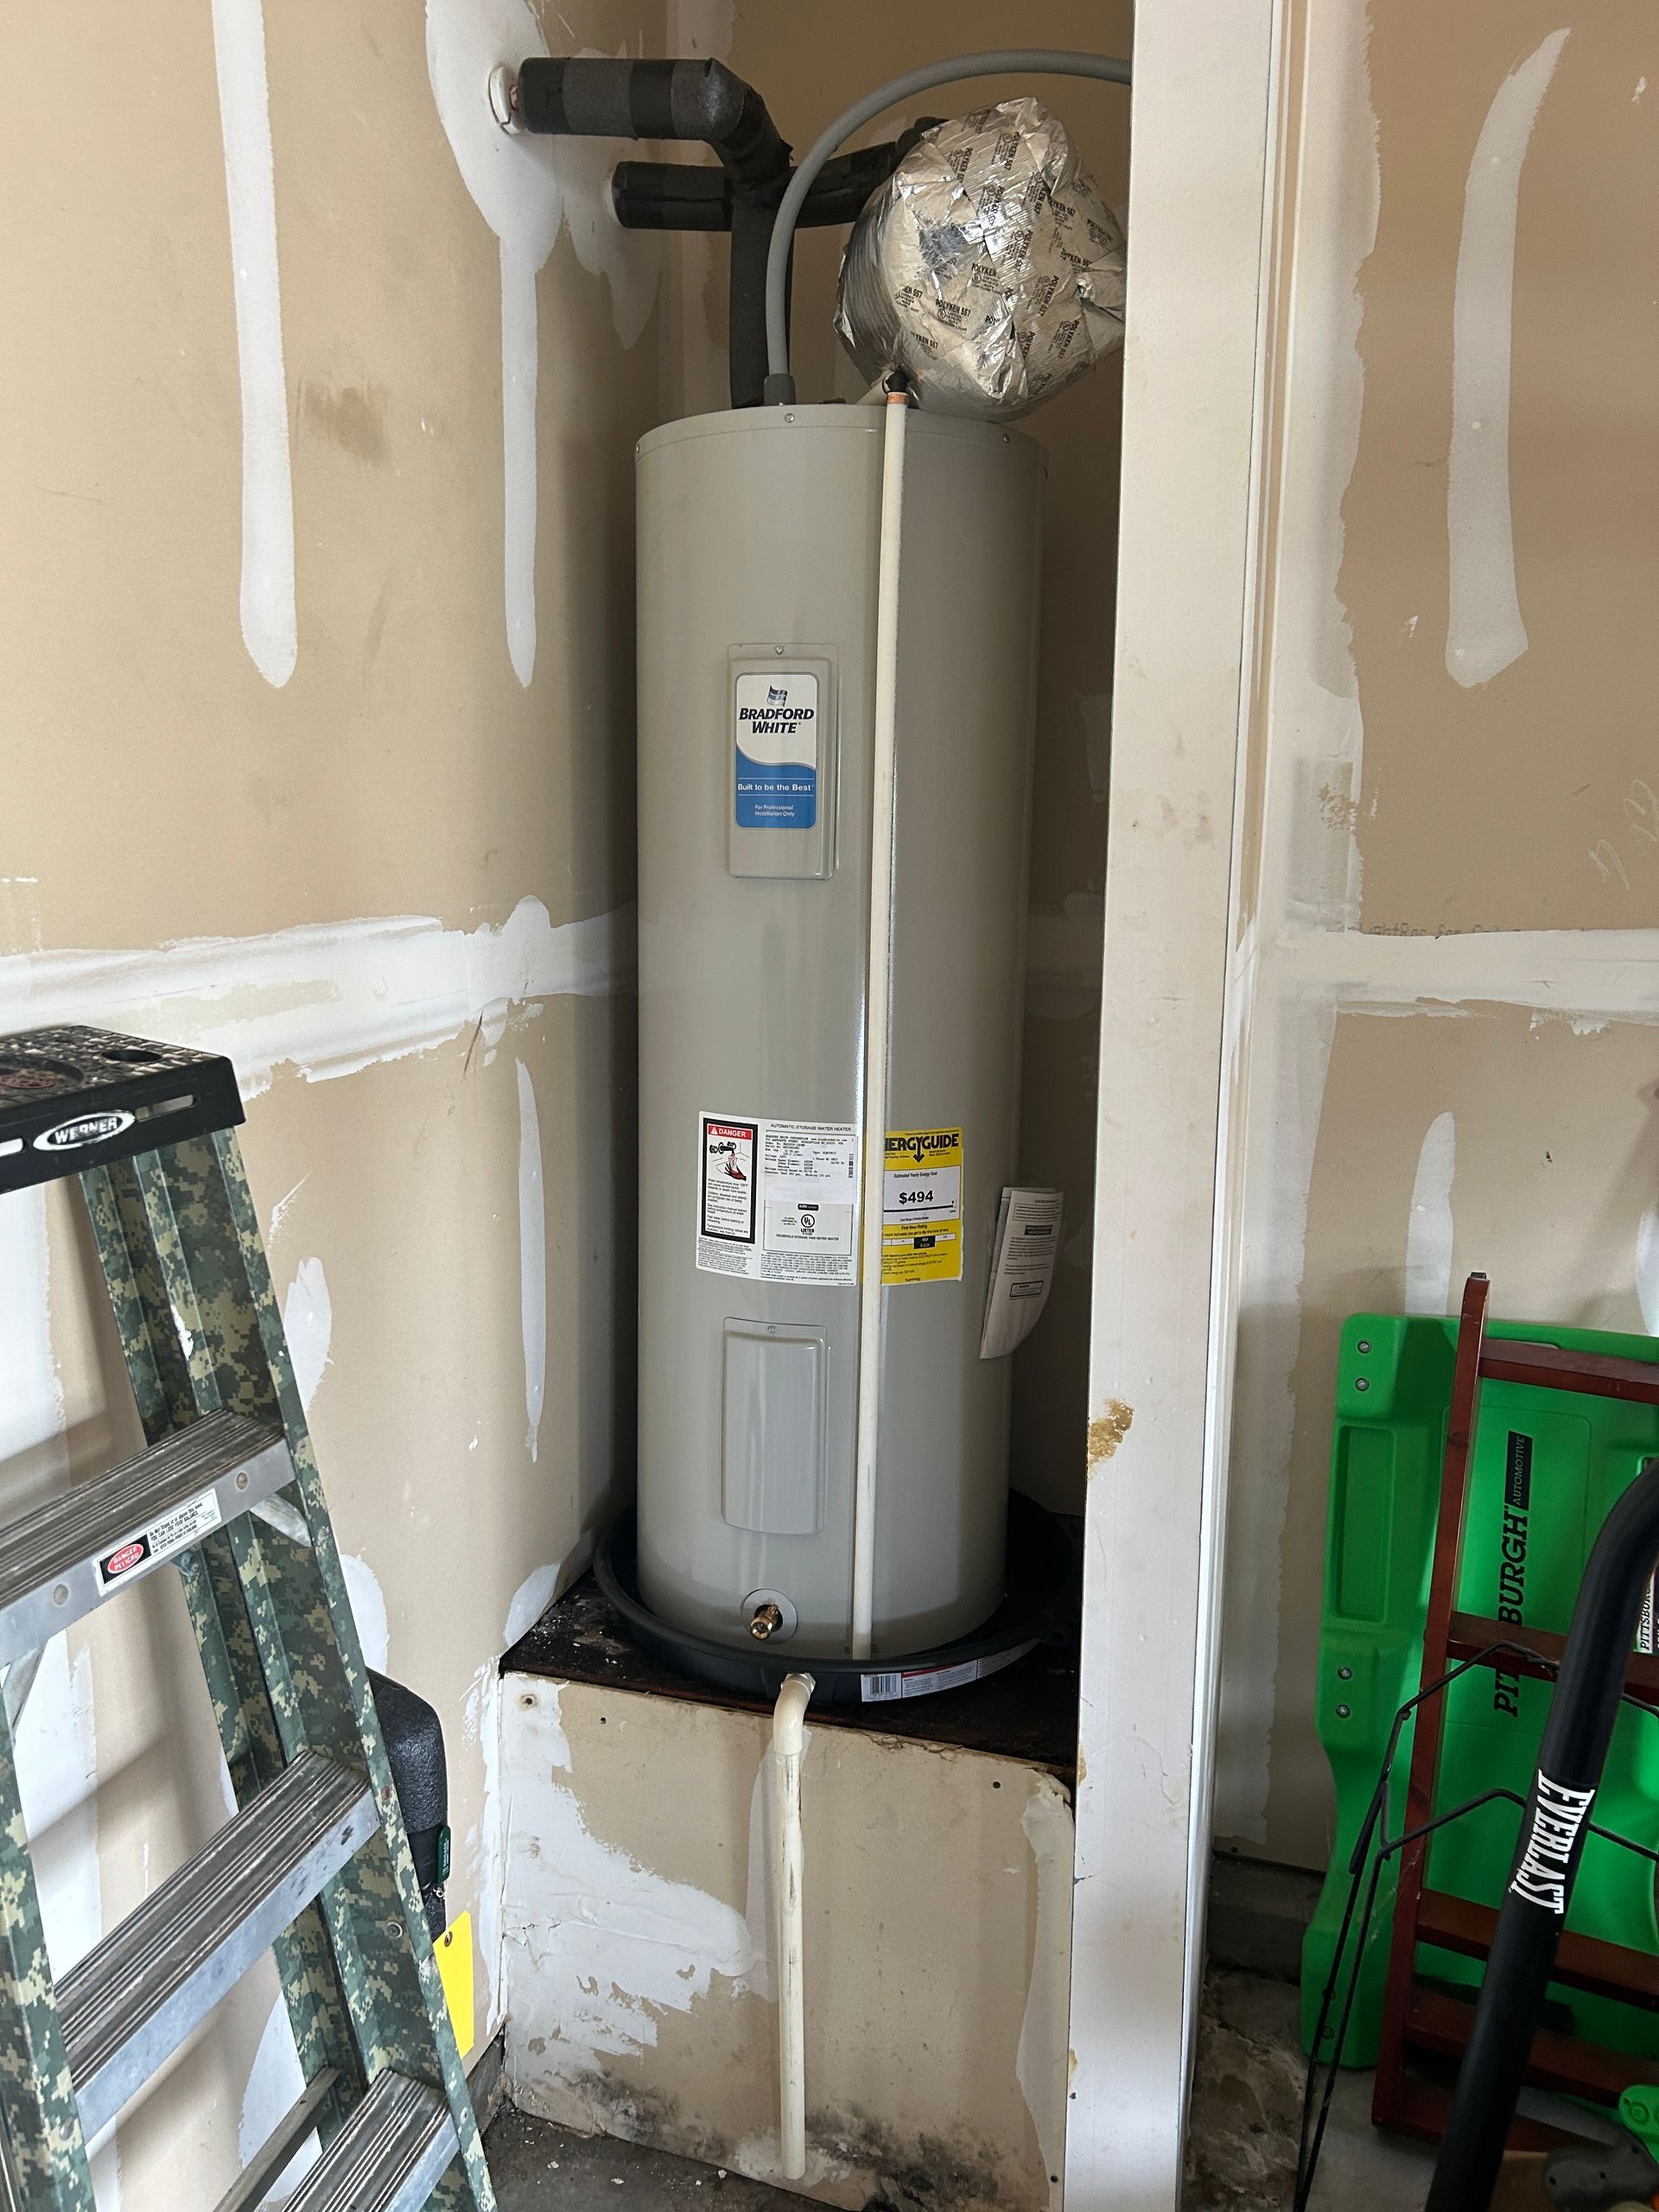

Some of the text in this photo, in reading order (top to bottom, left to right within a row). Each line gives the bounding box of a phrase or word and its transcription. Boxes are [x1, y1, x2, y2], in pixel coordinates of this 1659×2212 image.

[936, 298, 961, 315] POLYKEN
[739, 708, 815, 721] BRADFORD
[752, 721, 798, 734] WHITE
[54, 1116, 118, 1144] WERNER
[718, 1128, 747, 1138] DANGER
[885, 1134, 959, 1151] ERGYGUIDE
[899, 1190, 933, 1205] $494
[1512, 1434, 1526, 1508] AUTOMOTIVE
[113, 1547, 137, 1564] DANGER
[1494, 1510, 1529, 1719] PITBURGH
[1509, 1769, 1596, 1915] EVERLAST
